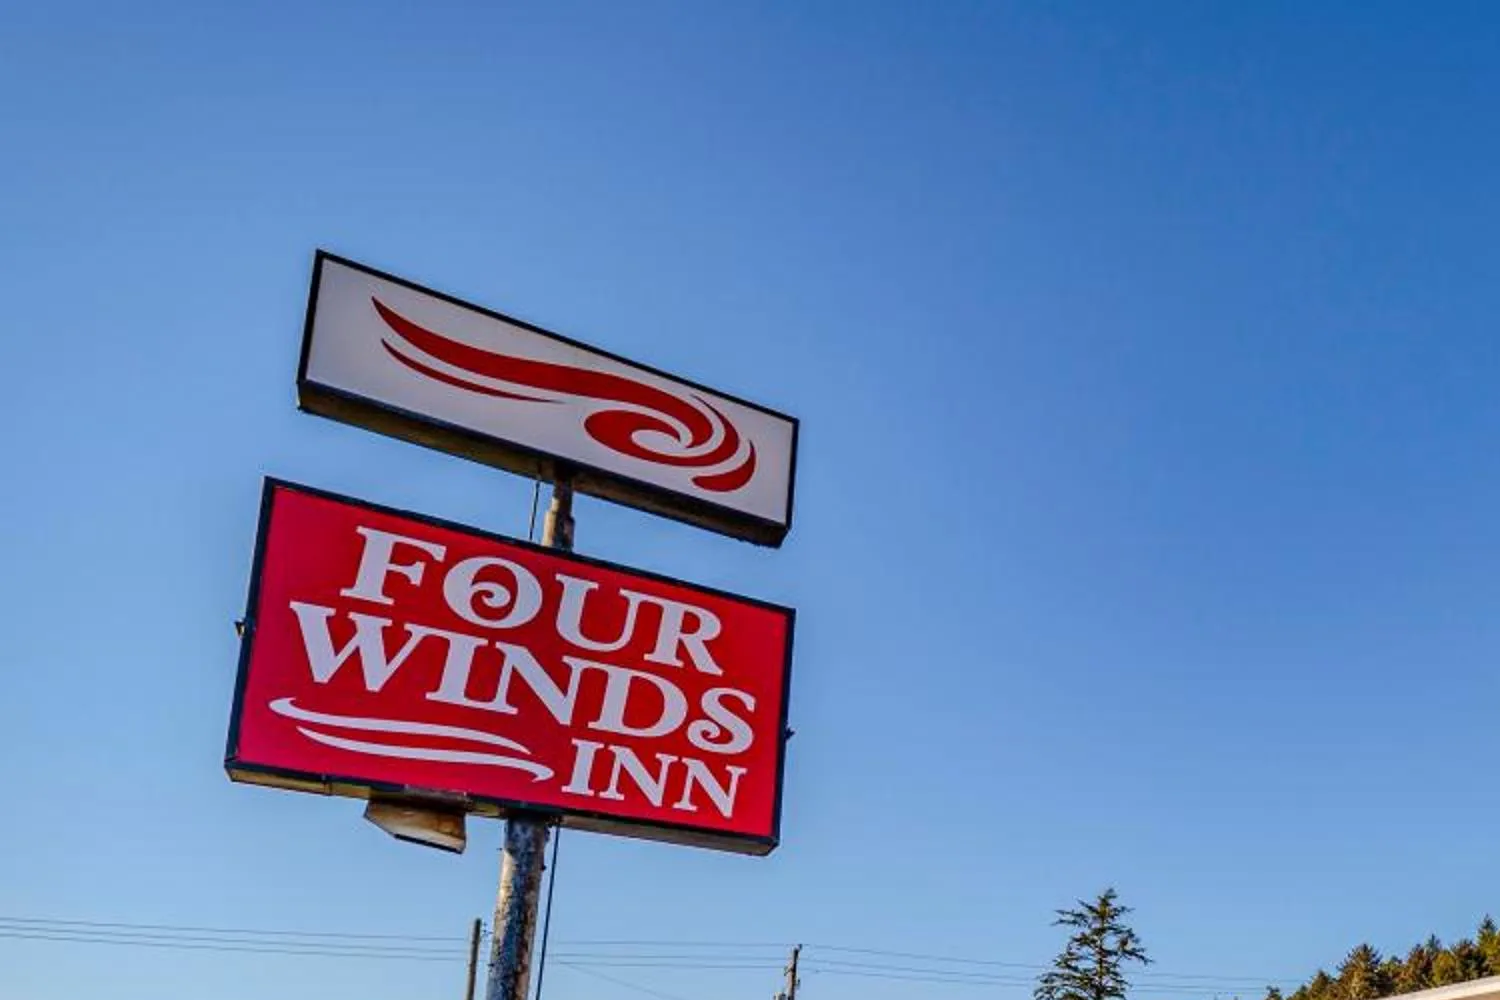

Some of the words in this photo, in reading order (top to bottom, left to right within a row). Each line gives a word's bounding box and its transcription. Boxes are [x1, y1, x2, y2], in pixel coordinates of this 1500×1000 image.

[340, 525, 723, 676] FOUR
[289, 601, 756, 755] WINDS
[561, 739, 748, 819] INN
